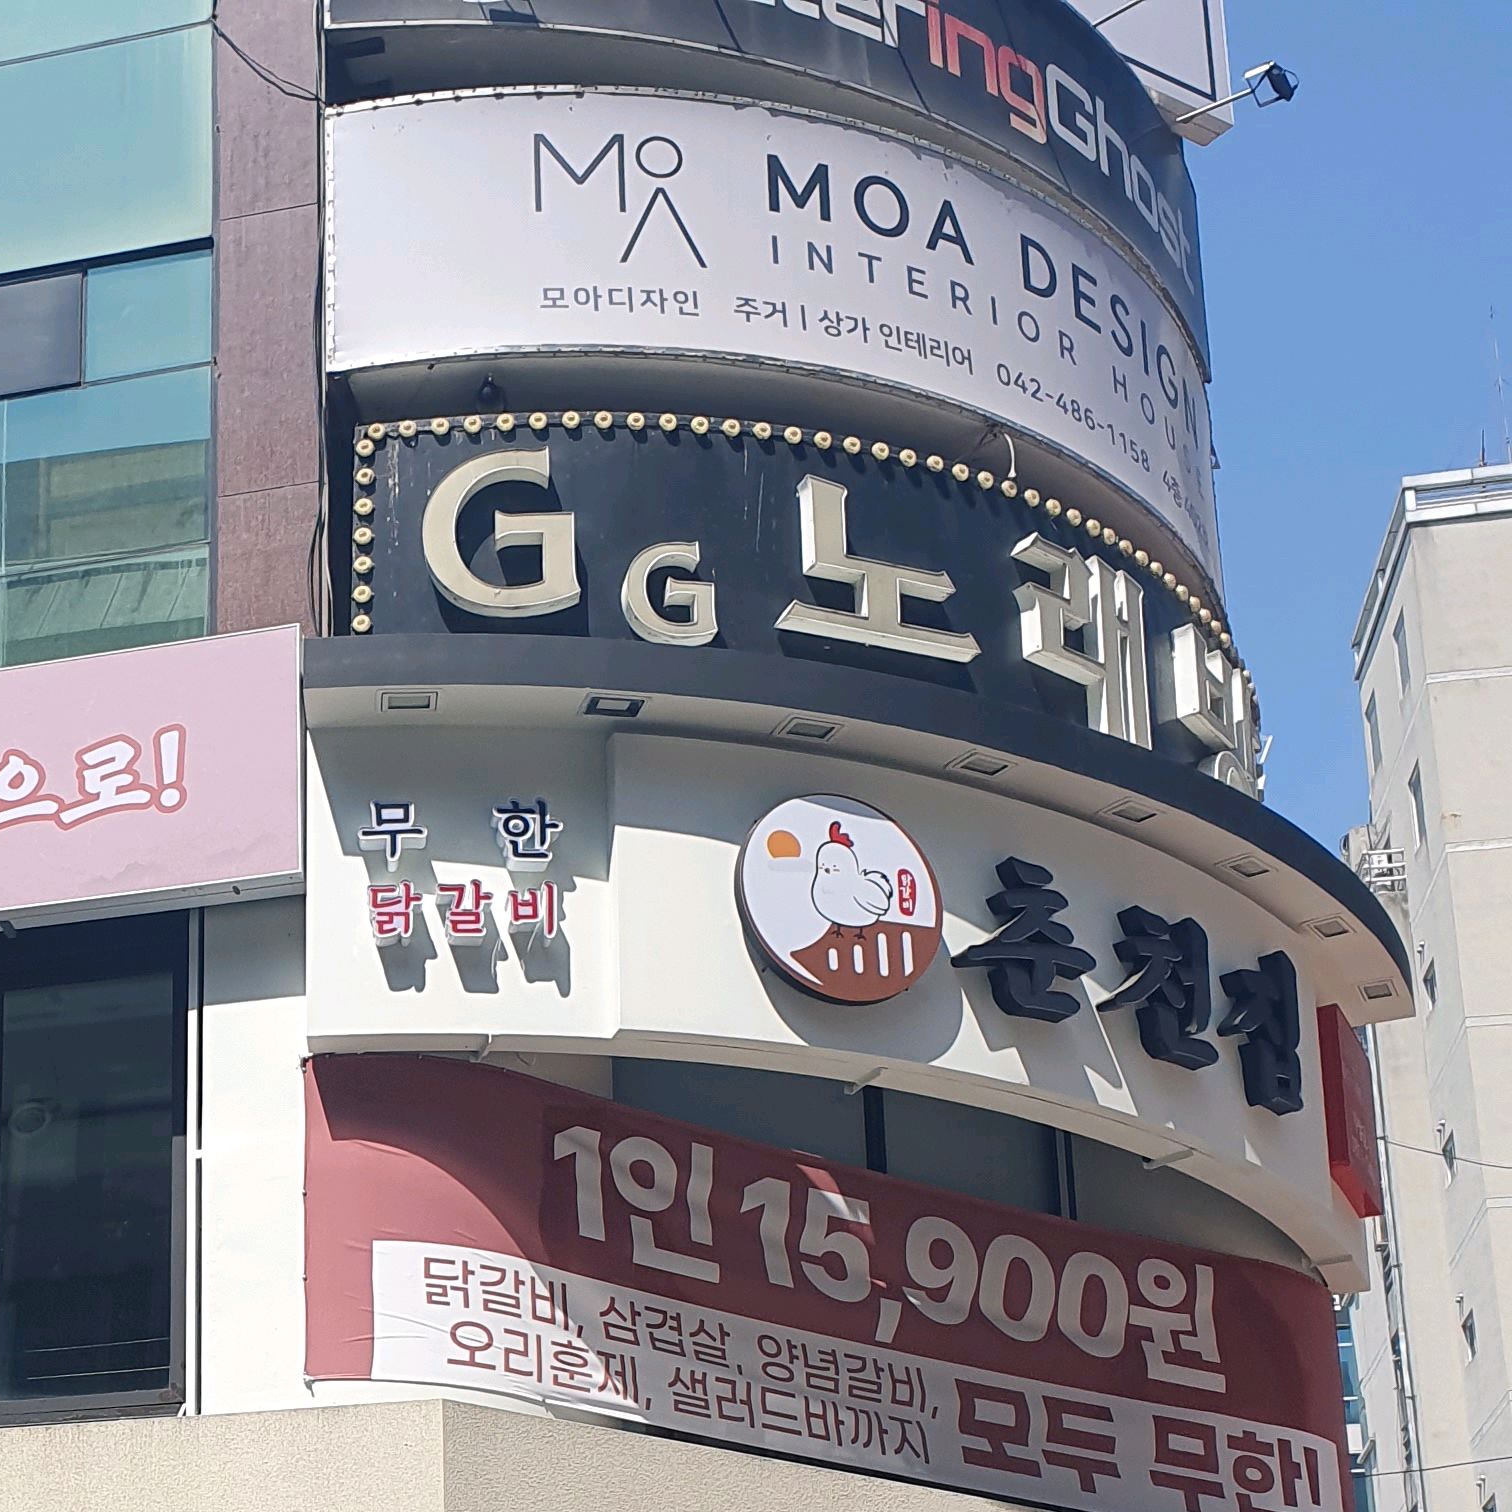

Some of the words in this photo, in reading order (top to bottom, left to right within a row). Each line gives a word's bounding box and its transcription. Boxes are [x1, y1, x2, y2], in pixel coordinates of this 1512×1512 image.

[540, 285, 701, 317] 모아디자인
[734, 297, 790, 328] 주거
[819, 310, 871, 344] 상가
[879, 323, 975, 376] 인테리어
[997, 363, 1150, 473] 042-486-1158
[767, 153, 974, 266] MOA
[1020, 232, 1200, 450] DESIGN
[772, 235, 1077, 366] INTERIOR
[367, 878, 560, 948] 닭갈비
[950, 855, 1306, 1117] 춘천집
[423, 1256, 584, 1339] 닭갈비,
[599, 1296, 743, 1376] 삼겹살,
[756, 1333, 939, 1420] 양념갈비,
[552, 1124, 721, 1285] 1인
[738, 1173, 1228, 1395] 15,900원
[446, 1320, 652, 1411] 오리훈제,
[667, 1366, 930, 1465] 샐러드바까지
[954, 1376, 1122, 1494] 모두
